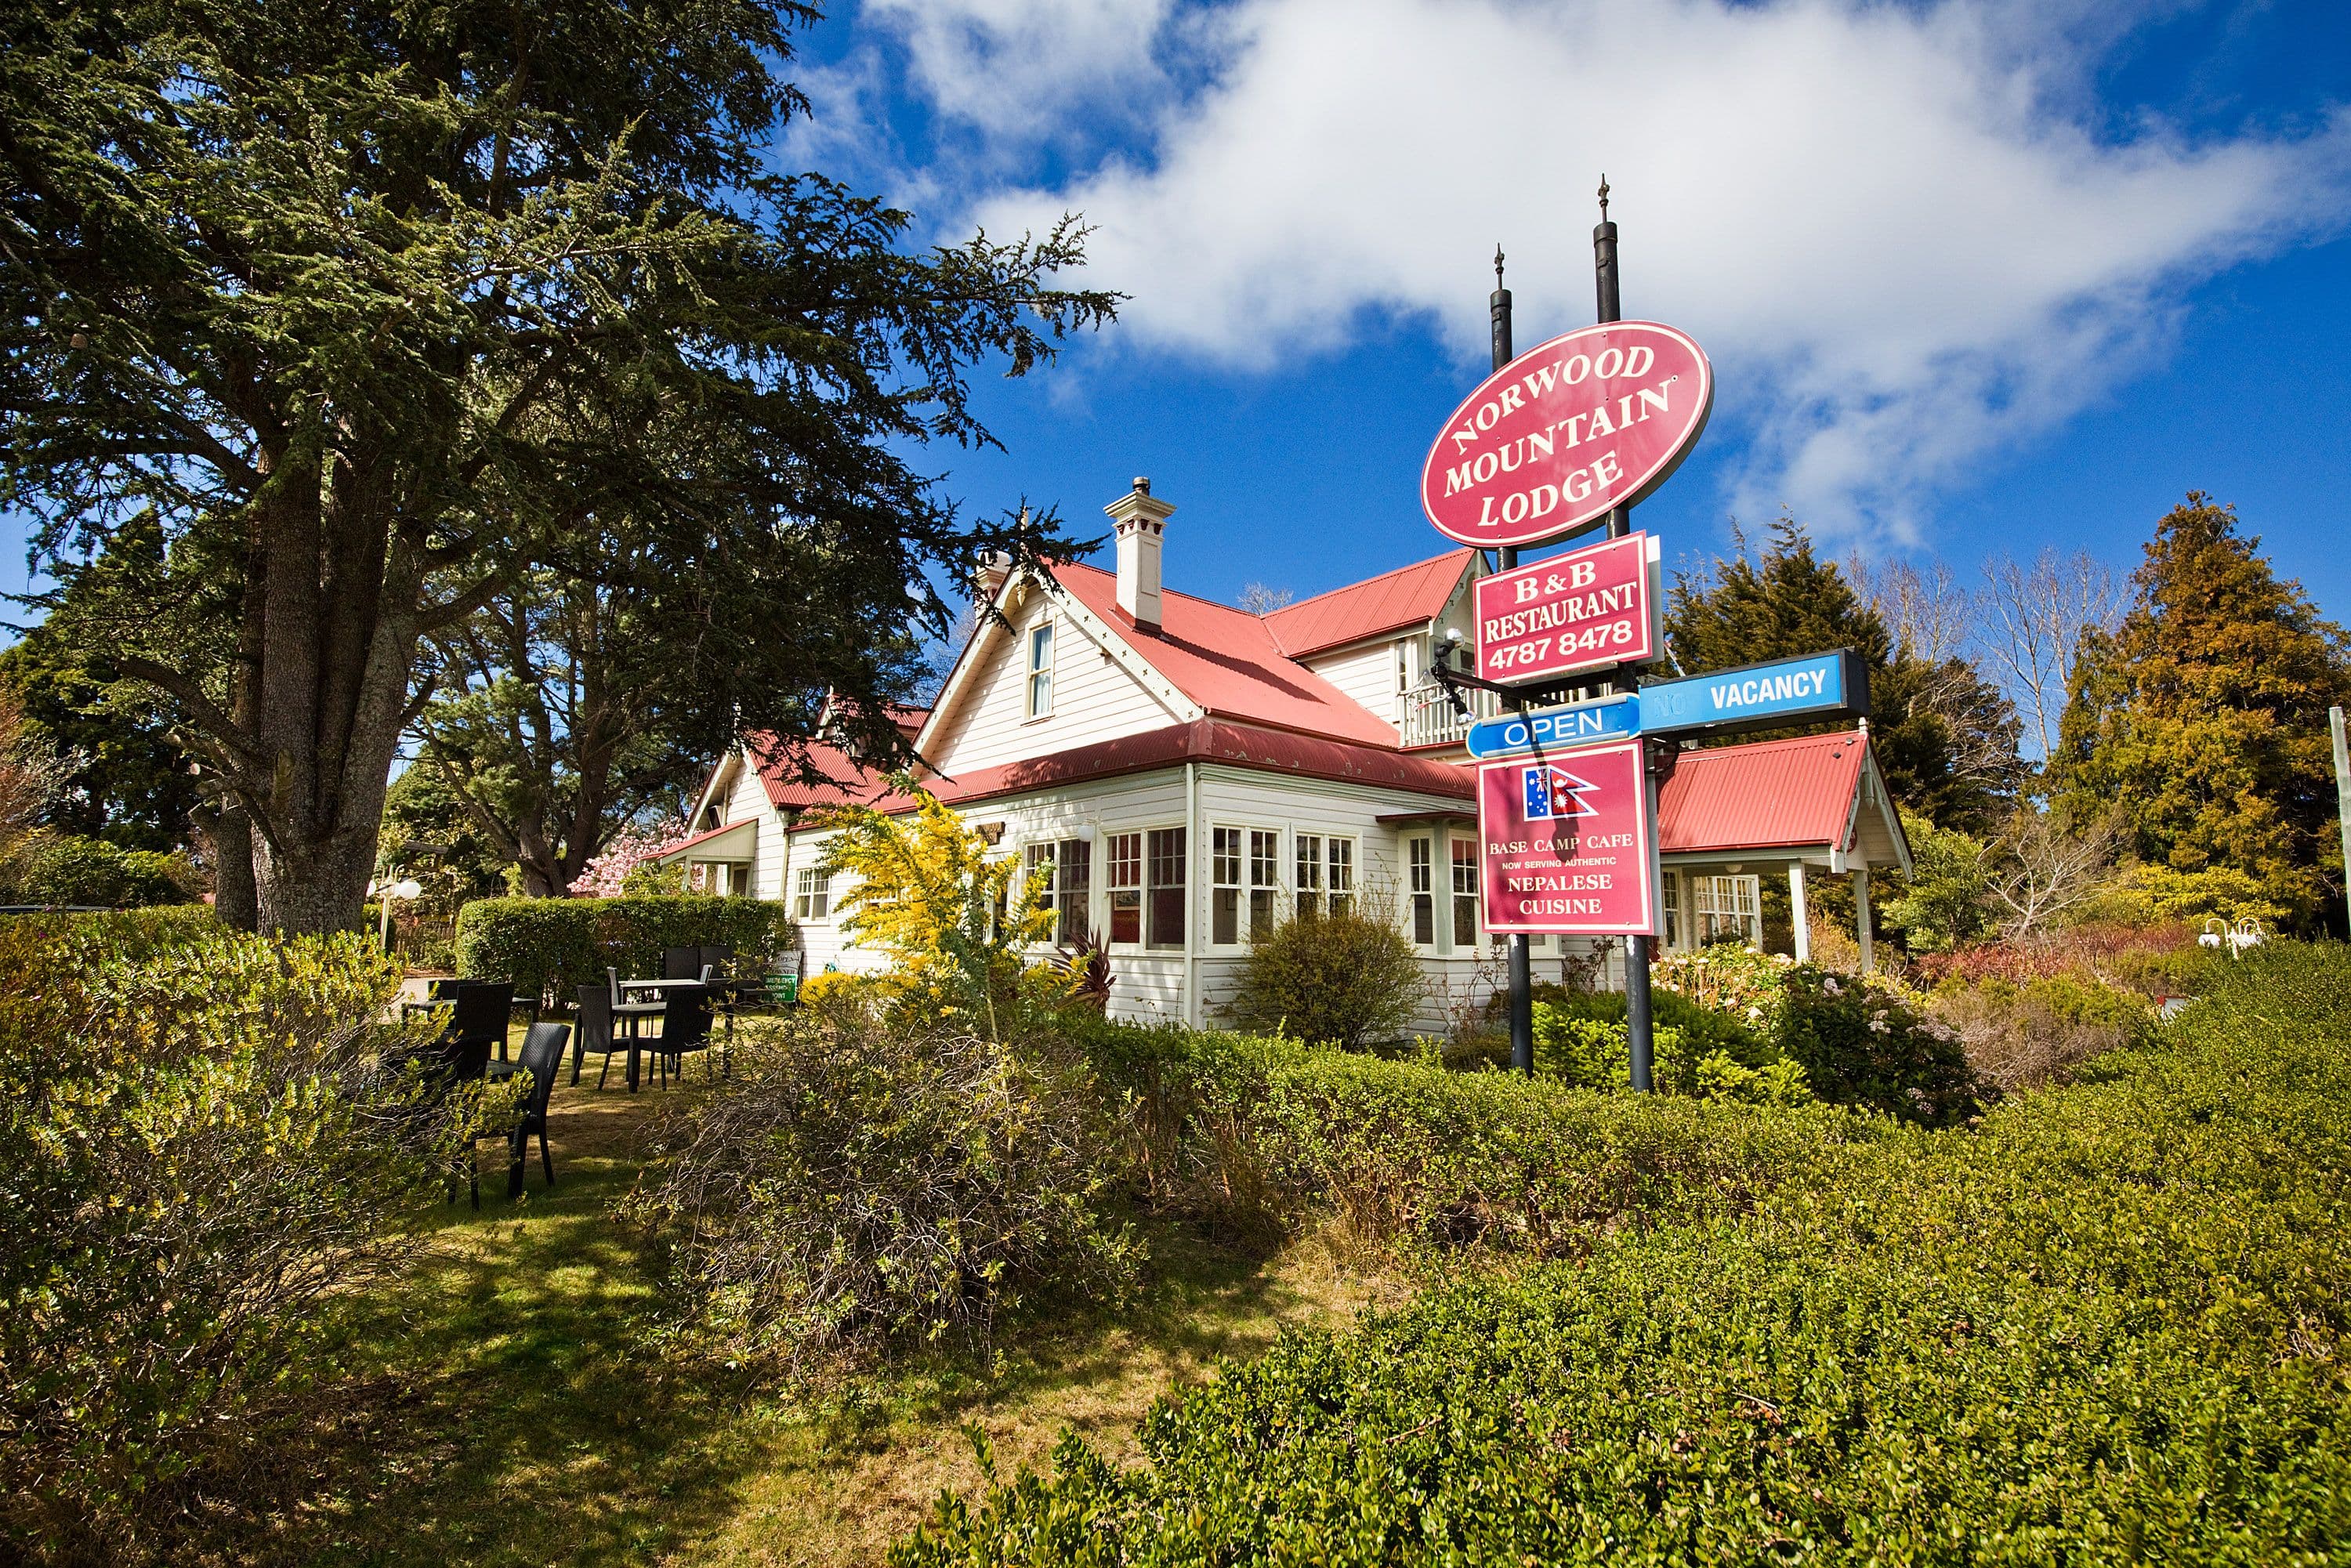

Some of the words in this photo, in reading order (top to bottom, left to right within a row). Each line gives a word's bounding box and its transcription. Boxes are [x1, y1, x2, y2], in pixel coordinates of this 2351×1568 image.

[1451, 346, 1655, 456] NORWOOD
[1444, 375, 1679, 498] MOUNTAIN
[1477, 450, 1624, 527] LODGE
[1484, 581, 1637, 644] RESTAURANT
[1489, 637, 1552, 669] 4787
[1558, 620, 1633, 656] 8478
[1711, 668, 1827, 709] VACANCY
[1504, 708, 1603, 746] OPEN
[1489, 841, 1528, 855] BASE
[1534, 838, 1580, 853] CAMP
[1587, 834, 1634, 849] CAFE
[1524, 860, 1562, 869] SERVING
[1565, 856, 1617, 867] AUTHENTIC
[1507, 874, 1614, 893] NEPALESE
[1519, 899, 1603, 915] CUISINE
